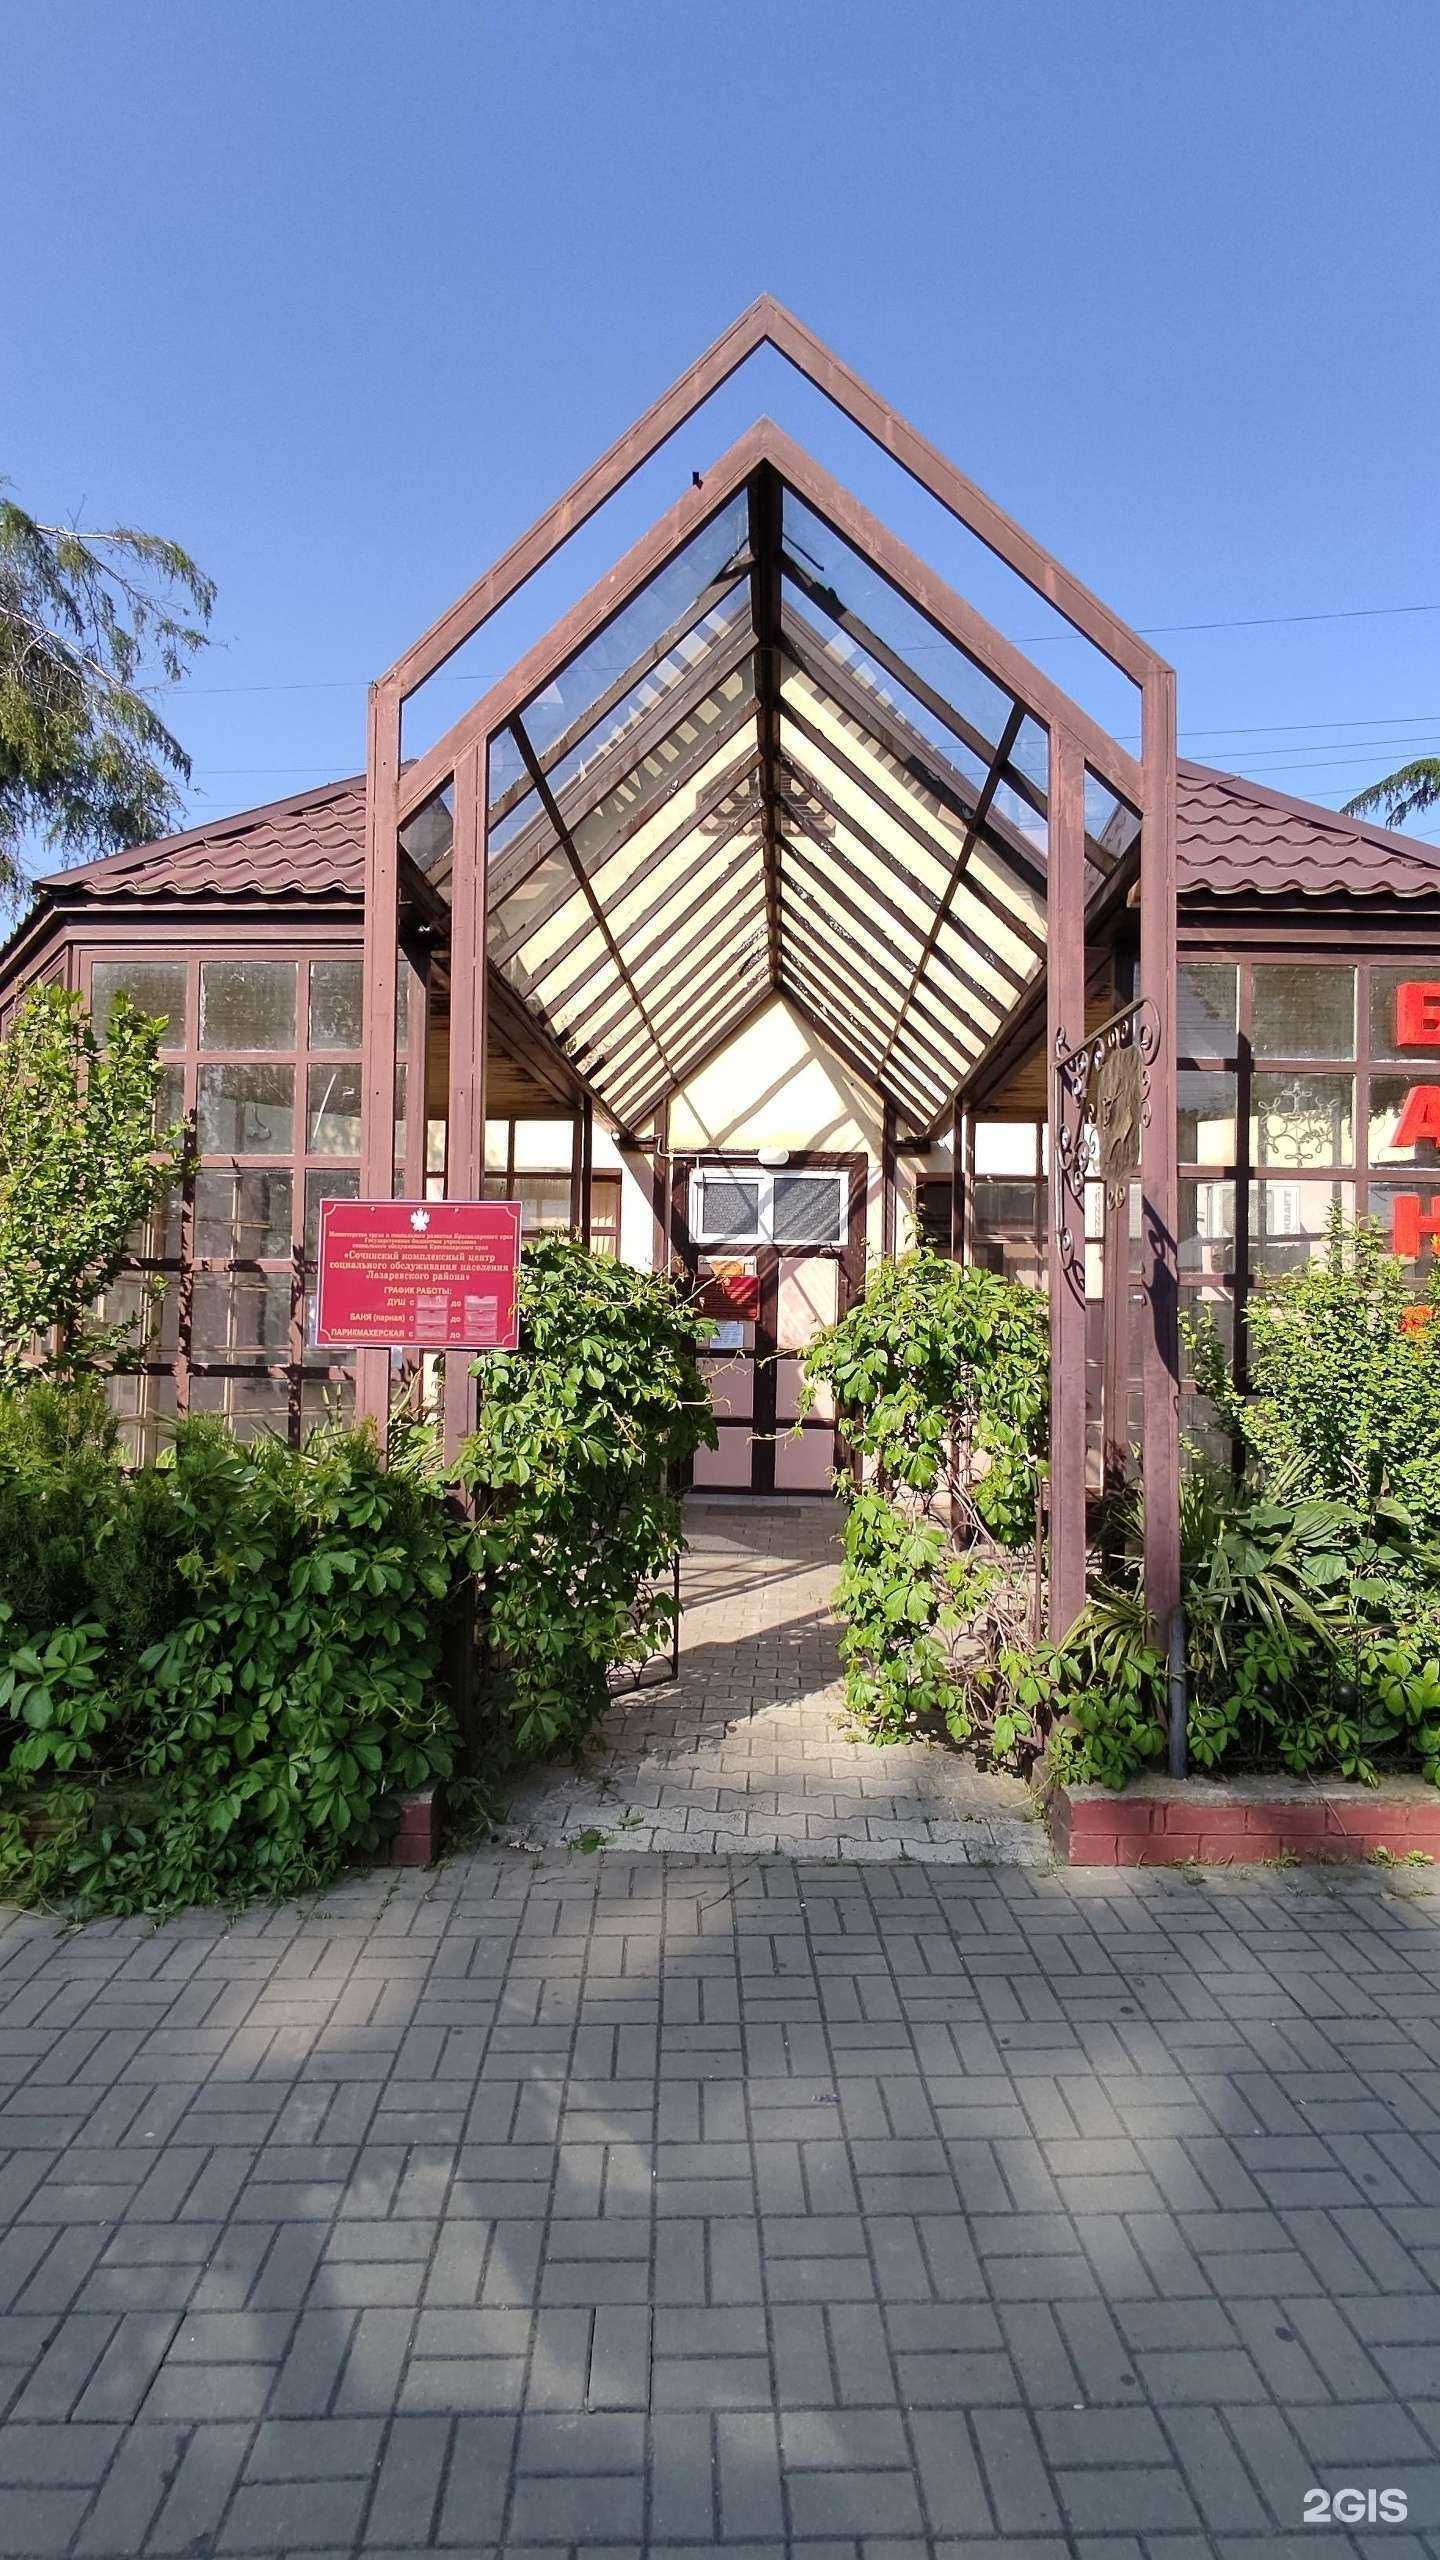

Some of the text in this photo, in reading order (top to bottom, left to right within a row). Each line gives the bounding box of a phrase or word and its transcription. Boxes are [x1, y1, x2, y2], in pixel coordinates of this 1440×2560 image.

[401, 1252, 465, 1262] комплексный
[468, 1253, 496, 1263] центр
[329, 1261, 387, 1271] социального
[460, 1264, 509, 1272] населения
[367, 1271, 429, 1282] Лазаревского
[383, 1286, 452, 1295] ГРАФИК РАБОТЫ:
[386, 1299, 406, 1307] ДУШ
[350, 1312, 372, 1321] БАНЯ
[331, 1328, 405, 1338] ПАРИКМАХЕРСКАЯ
